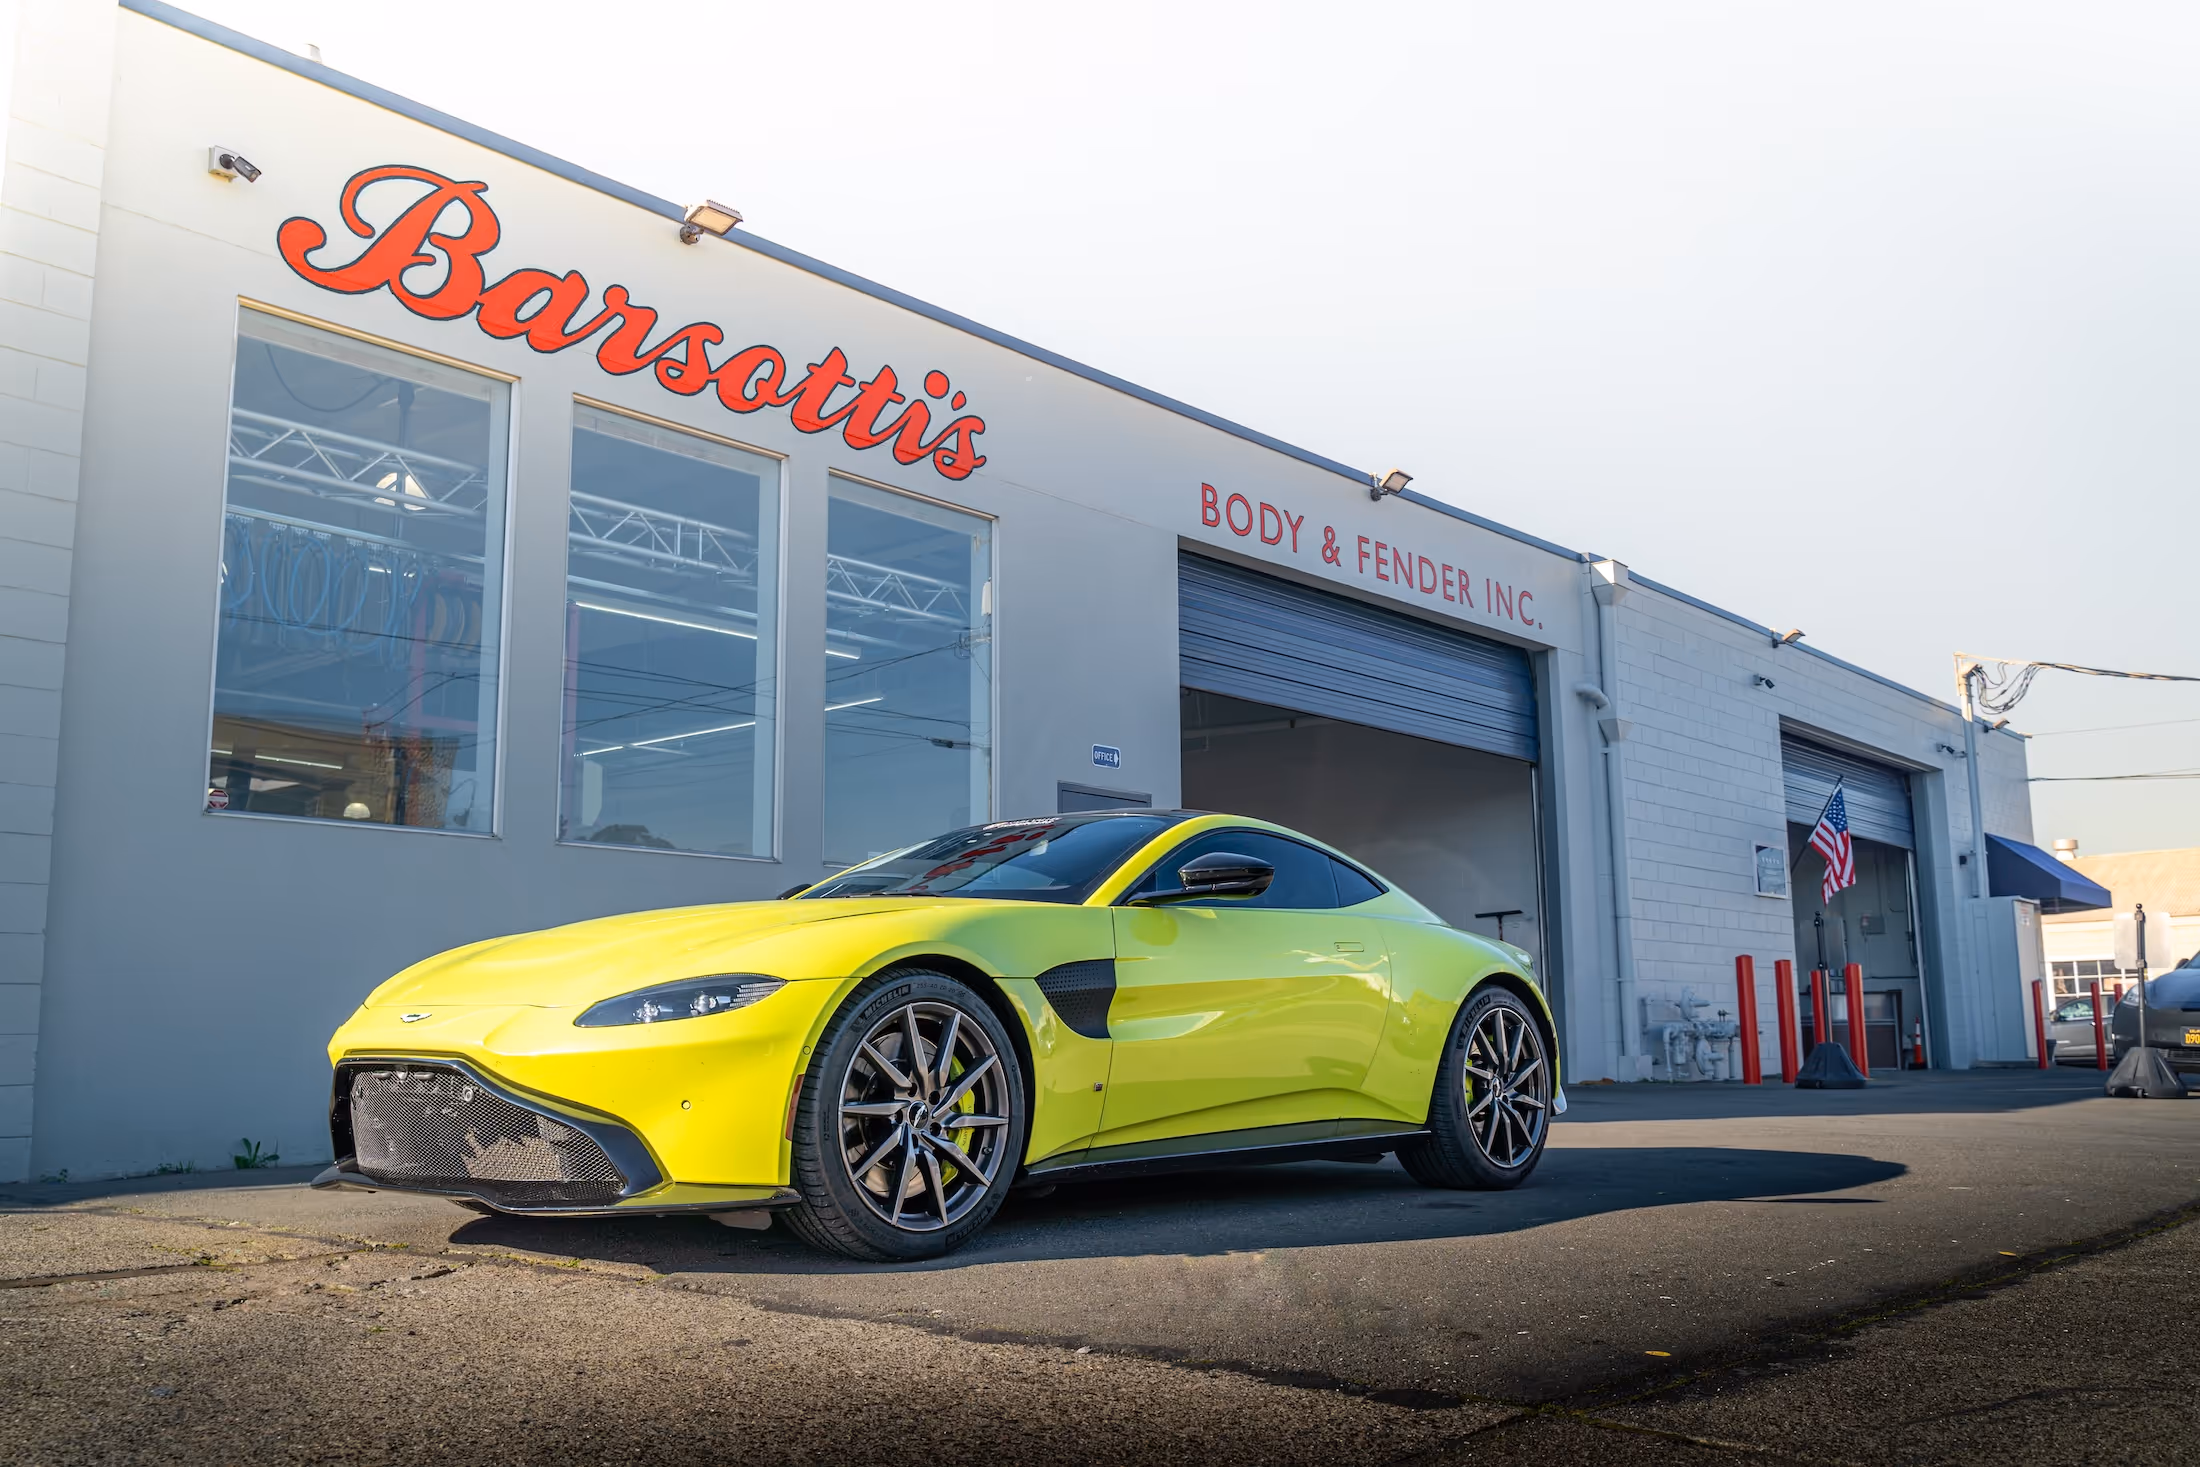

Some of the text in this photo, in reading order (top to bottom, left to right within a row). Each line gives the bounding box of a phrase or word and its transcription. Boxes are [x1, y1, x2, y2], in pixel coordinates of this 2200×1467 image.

[277, 164, 986, 480] Barsotti's
[1201, 482, 1543, 630] BODY & FENDER INC.
[1094, 750, 1113, 762] OFFICE
[864, 984, 911, 1019] MICHELIN
[1462, 994, 1491, 1034] MICHELIN
